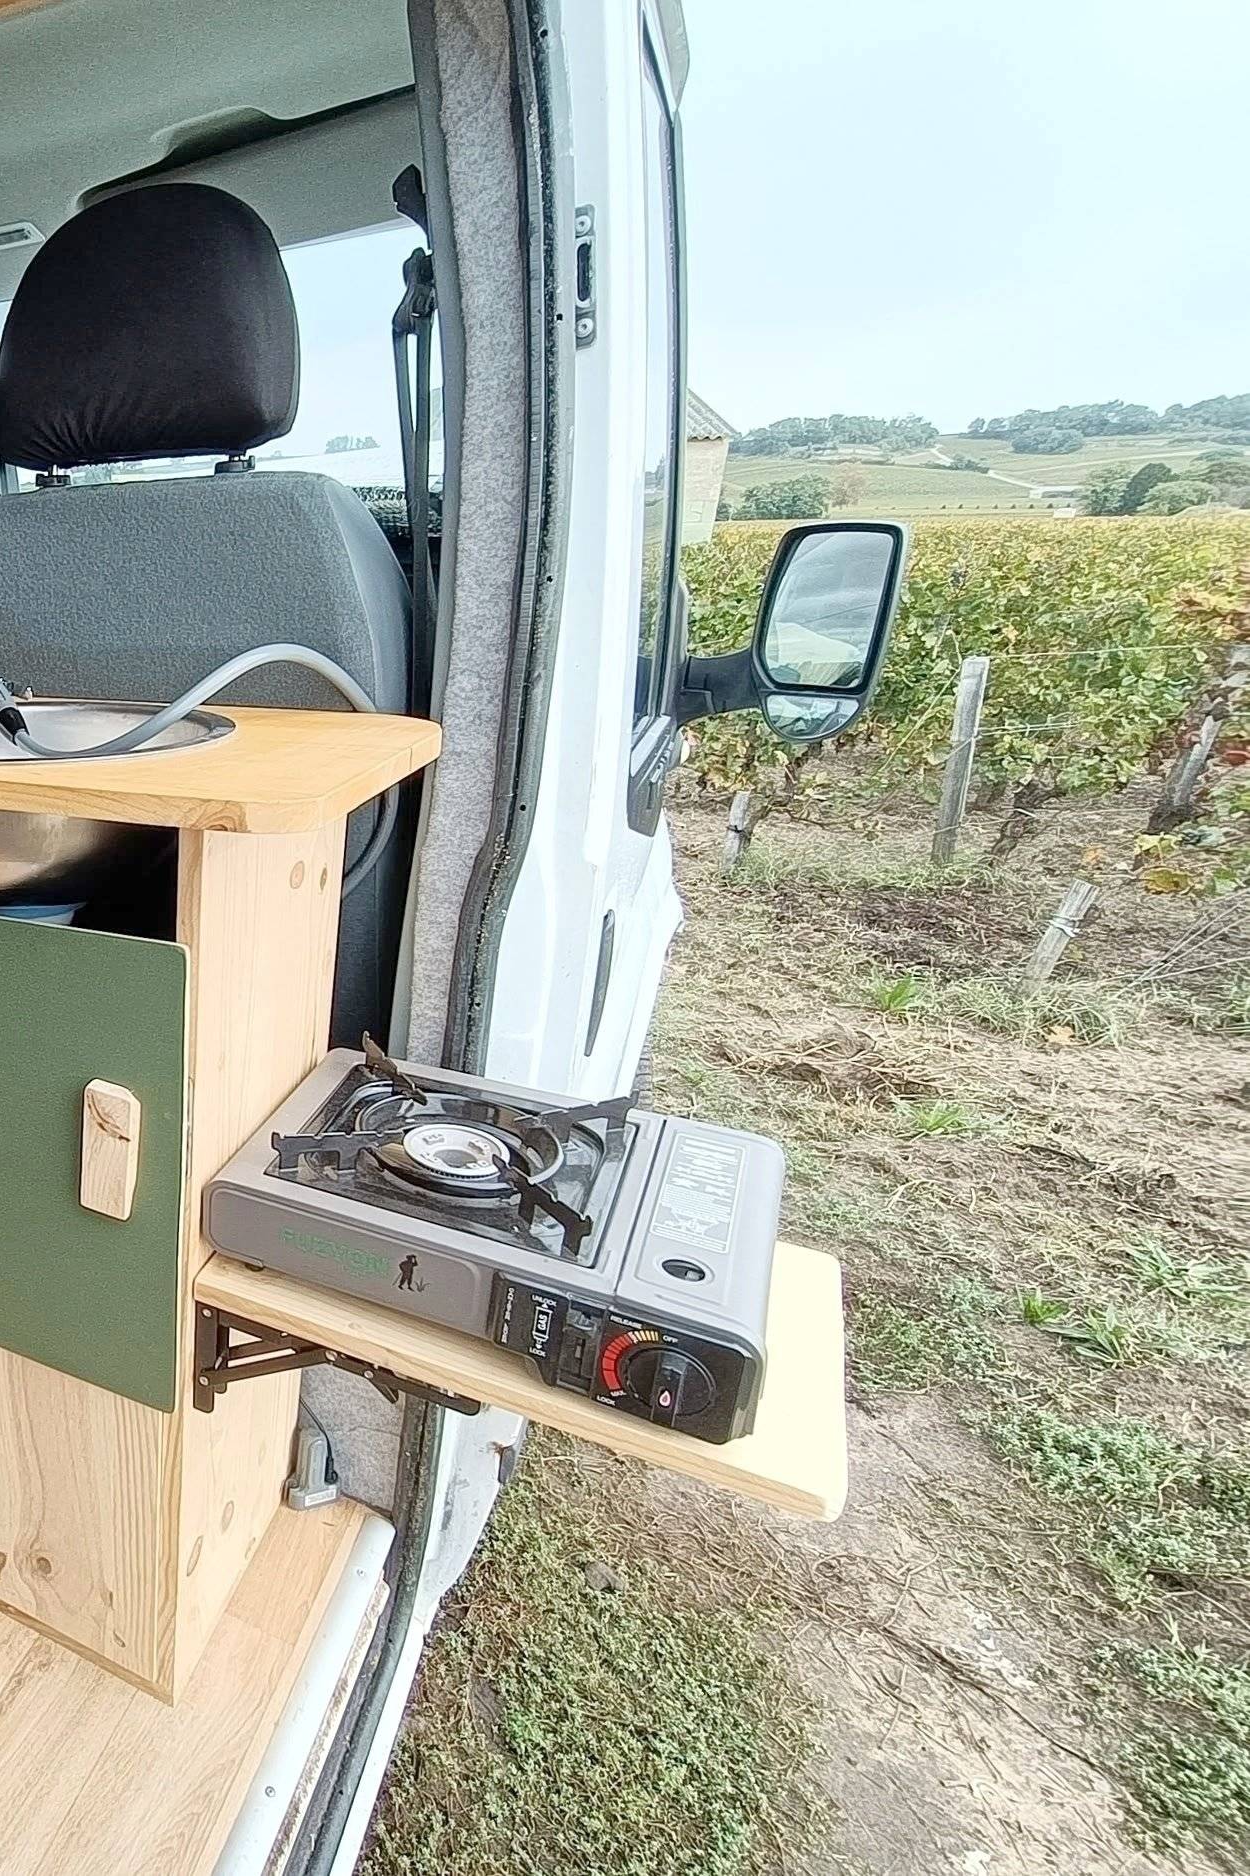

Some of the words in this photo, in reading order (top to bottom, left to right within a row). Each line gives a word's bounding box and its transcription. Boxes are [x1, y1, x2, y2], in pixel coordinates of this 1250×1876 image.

[532, 1294, 557, 1307] UNLOCK
[537, 1314, 548, 1331] GAS
[610, 1315, 642, 1329] RELEASE
[529, 1346, 547, 1358] LOCK
[596, 1394, 616, 1406] LOCK
